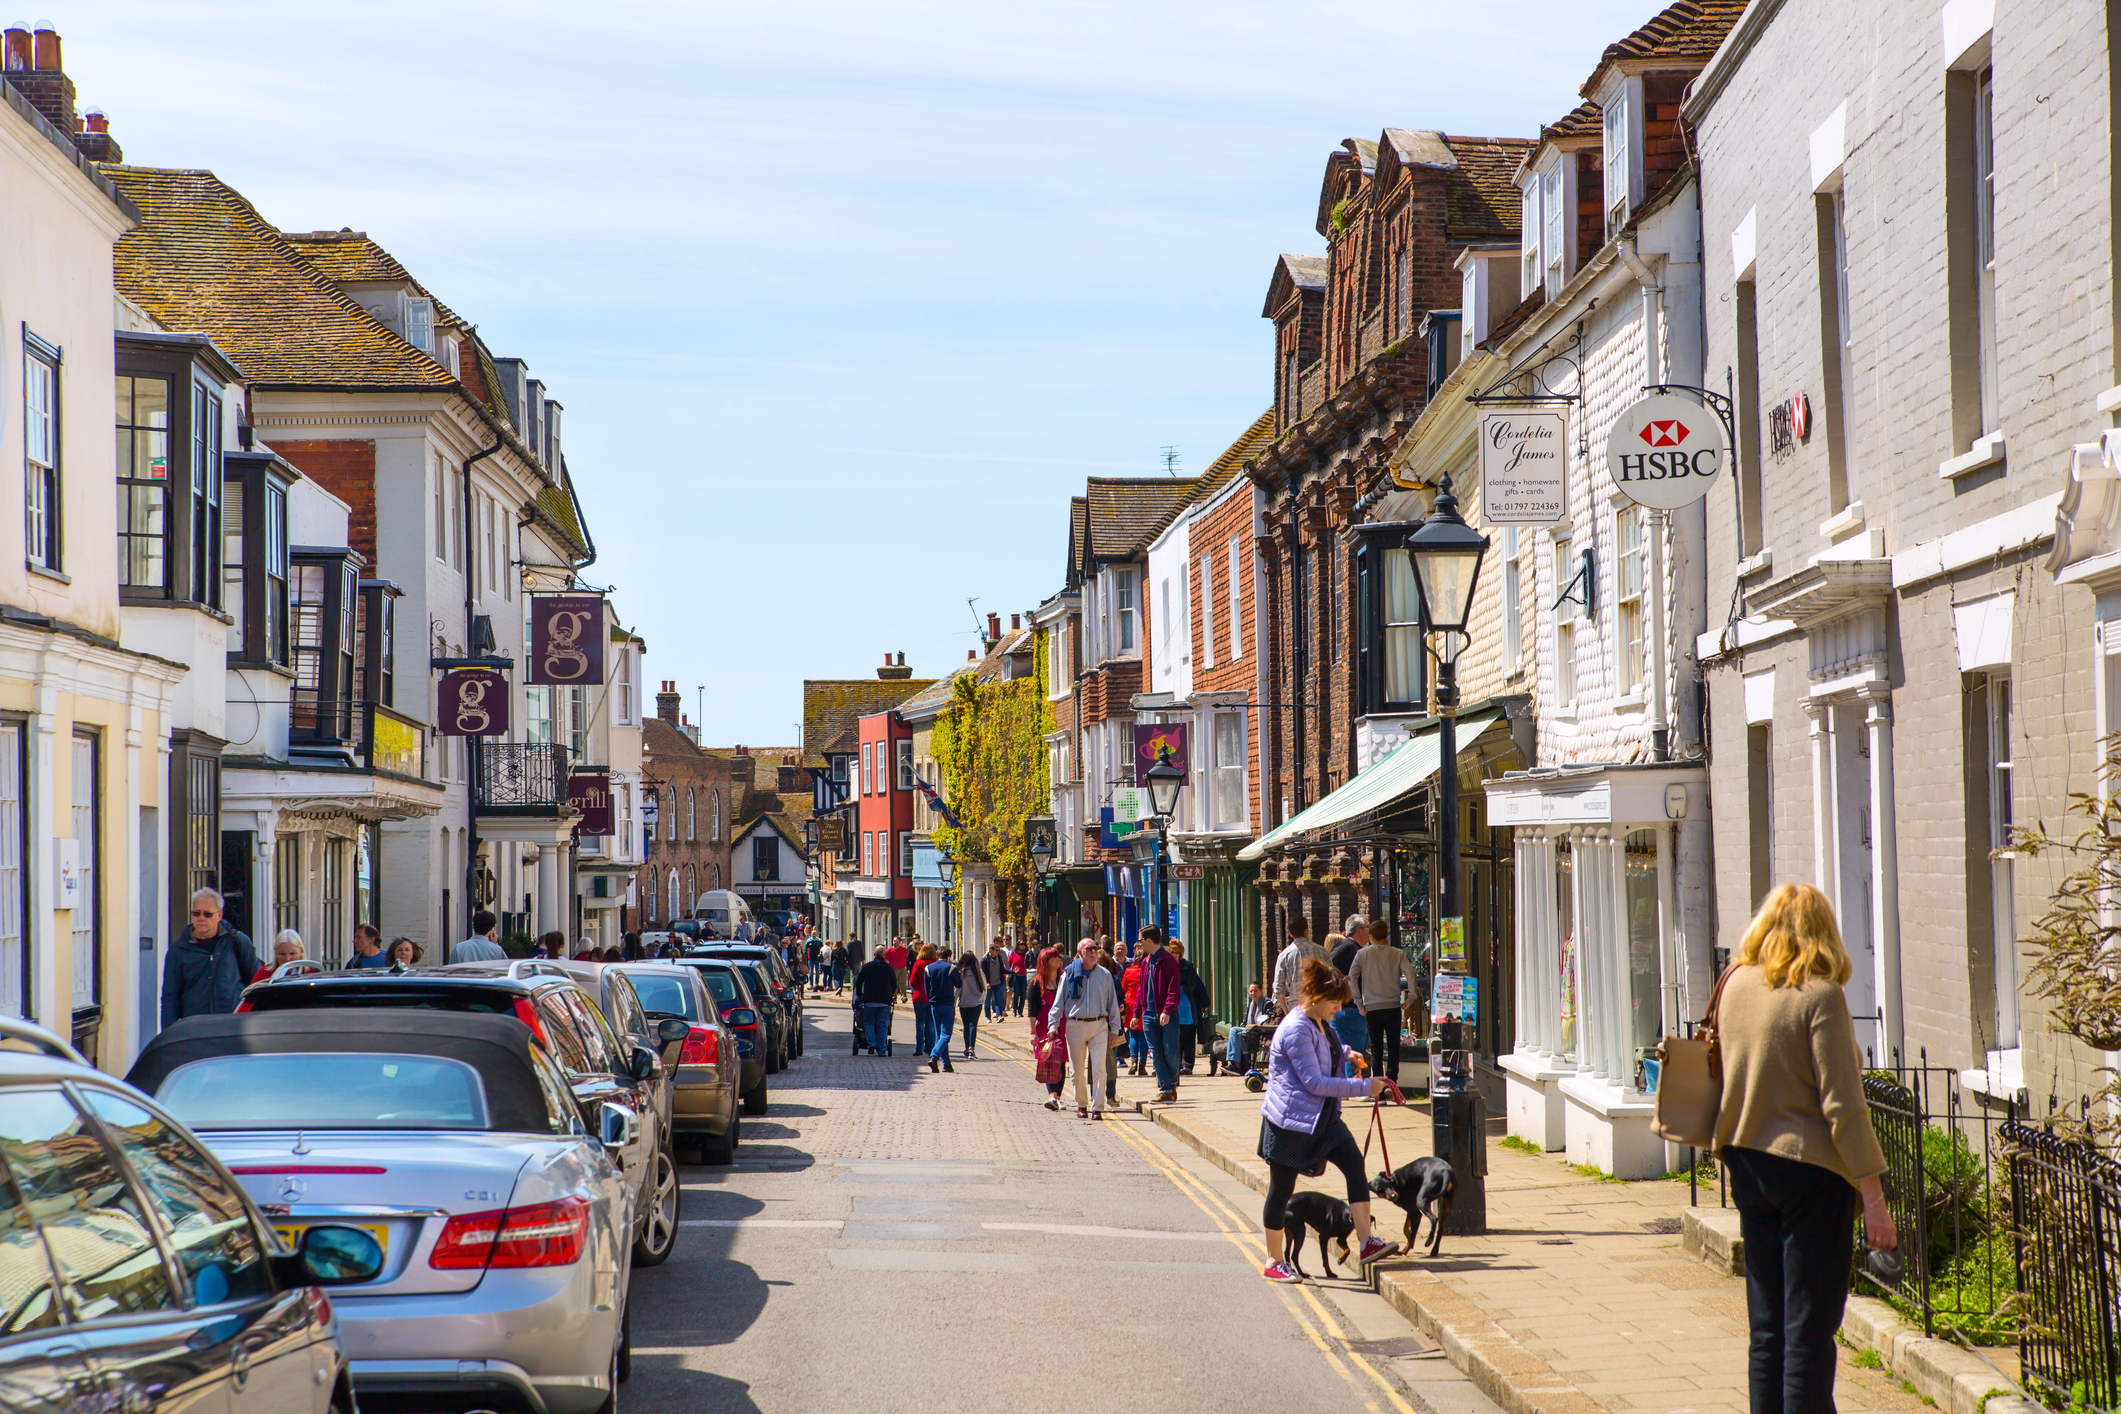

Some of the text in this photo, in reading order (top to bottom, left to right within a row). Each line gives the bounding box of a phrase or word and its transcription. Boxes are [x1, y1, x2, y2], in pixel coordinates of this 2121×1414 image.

[1490, 421, 1555, 449] Cordelia
[1504, 440, 1557, 472] James
[1619, 449, 1716, 481] HSBC
[1489, 479, 1516, 487] clothing
[1504, 488, 1518, 497] gifts
[1490, 502, 1559, 511] Tel: 01797 224369
[569, 787, 607, 815] grill
[464, 1189, 500, 1201] CDI
